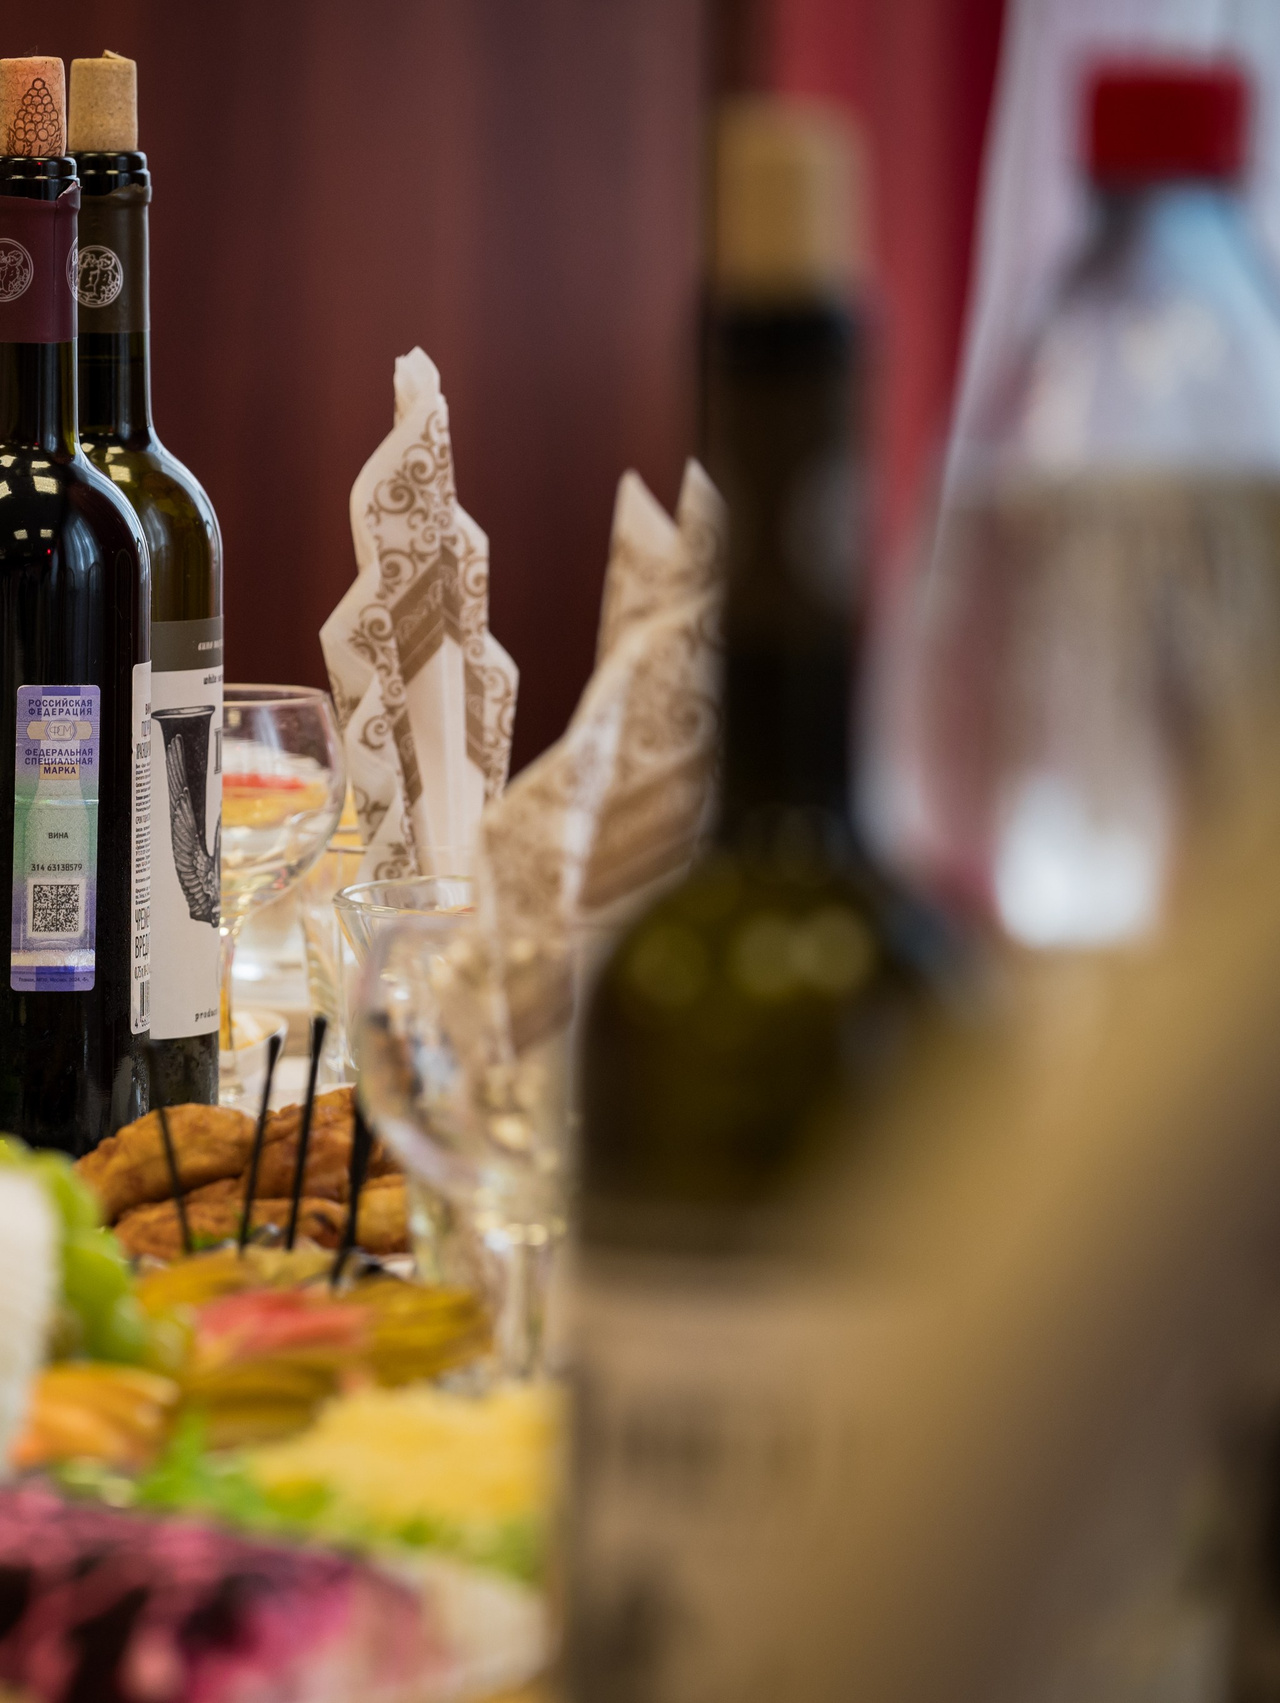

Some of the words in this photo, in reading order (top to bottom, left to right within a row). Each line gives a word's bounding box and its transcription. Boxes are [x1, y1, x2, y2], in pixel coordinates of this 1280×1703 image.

[28, 698, 93, 707] РОССИЙСКАЯ
[28, 707, 93, 717] ФЕДЕРАЦИЯ
[24, 748, 93, 757] ФЕДЕРАЛЬНАЯ
[24, 757, 93, 766] СПЕЦИАЛЬНАЯ
[43, 766, 77, 774] МАРКА
[31, 863, 45, 871] 314
